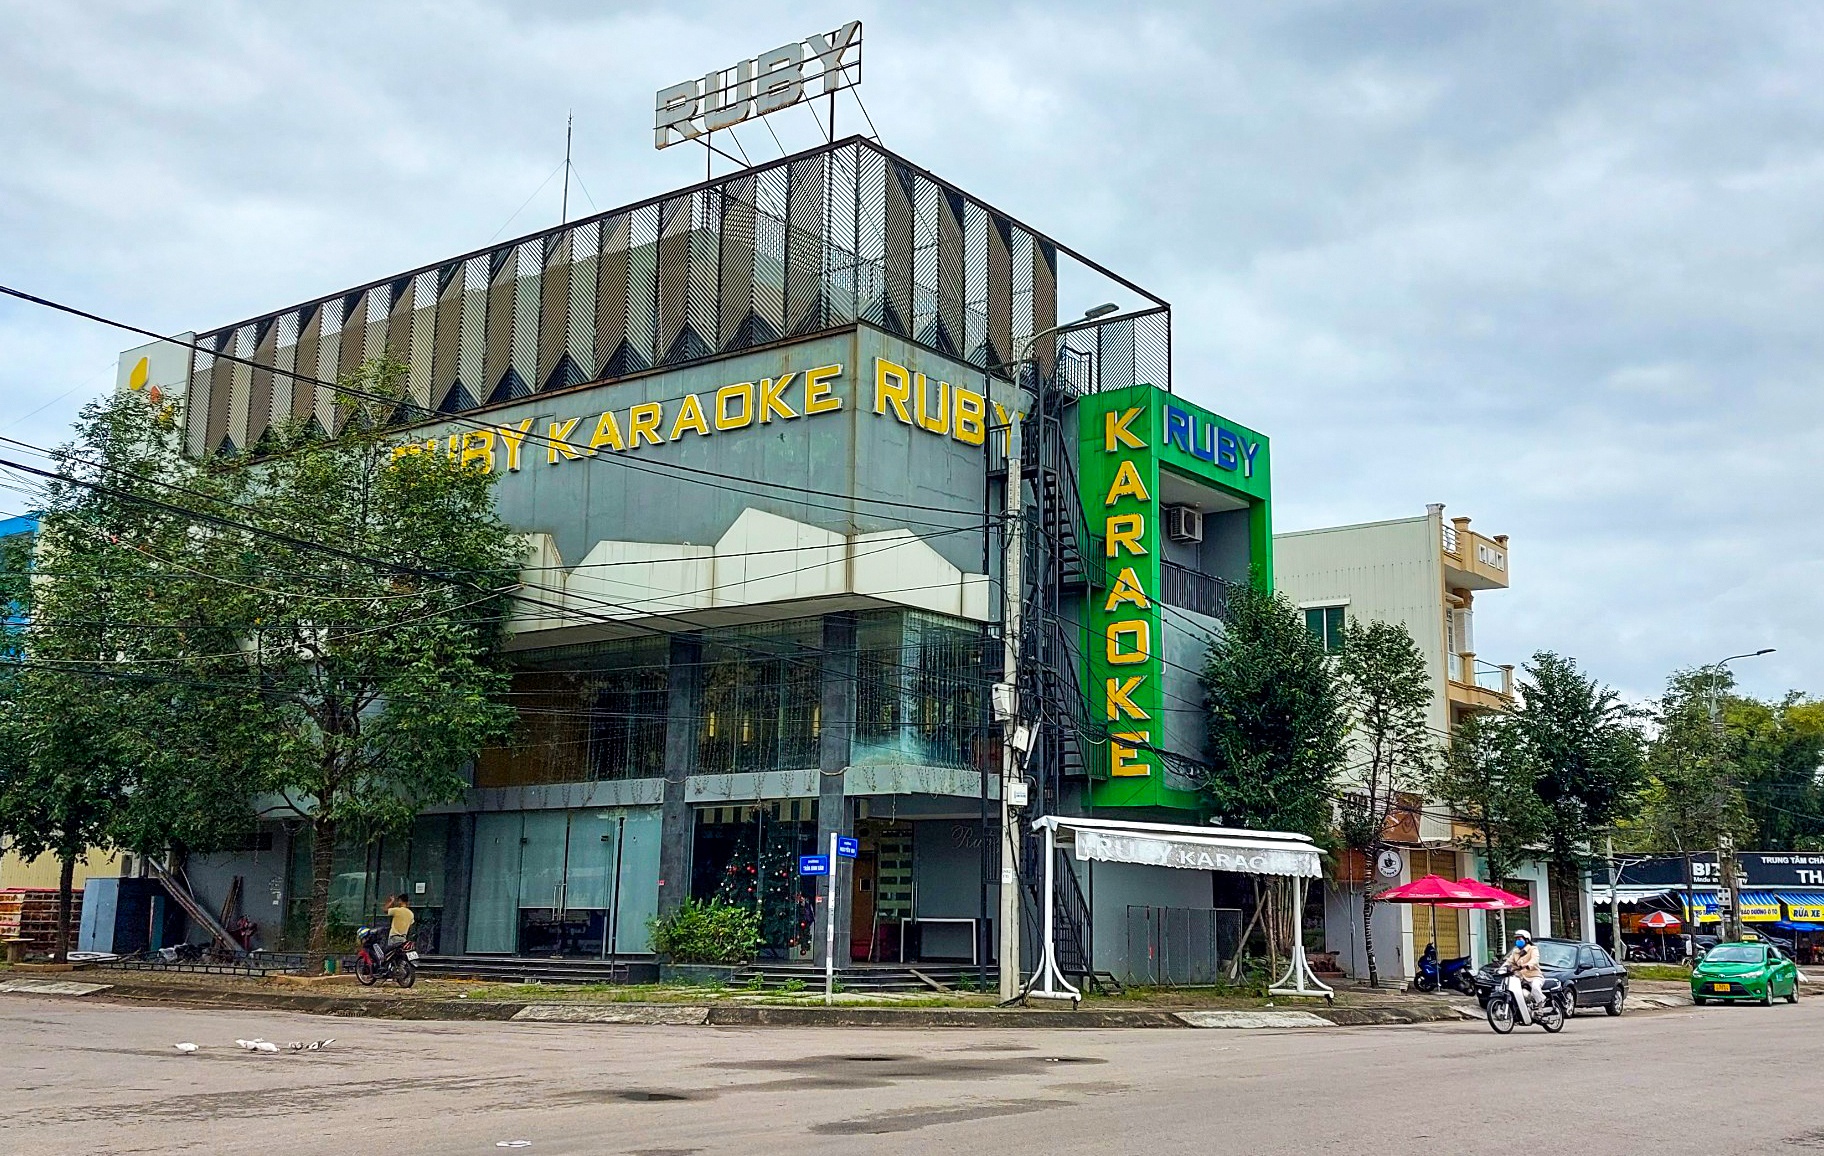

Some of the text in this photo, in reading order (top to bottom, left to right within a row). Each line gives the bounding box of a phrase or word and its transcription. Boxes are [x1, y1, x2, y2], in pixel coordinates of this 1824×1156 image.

[655, 20, 862, 150] RUBY
[547, 364, 843, 465] KARAOKE
[1163, 404, 1260, 478] RUBY
[1105, 406, 1151, 778] KARAOKE
[1796, 870, 1824, 884] TH
[1811, 909, 1820, 917] XE
